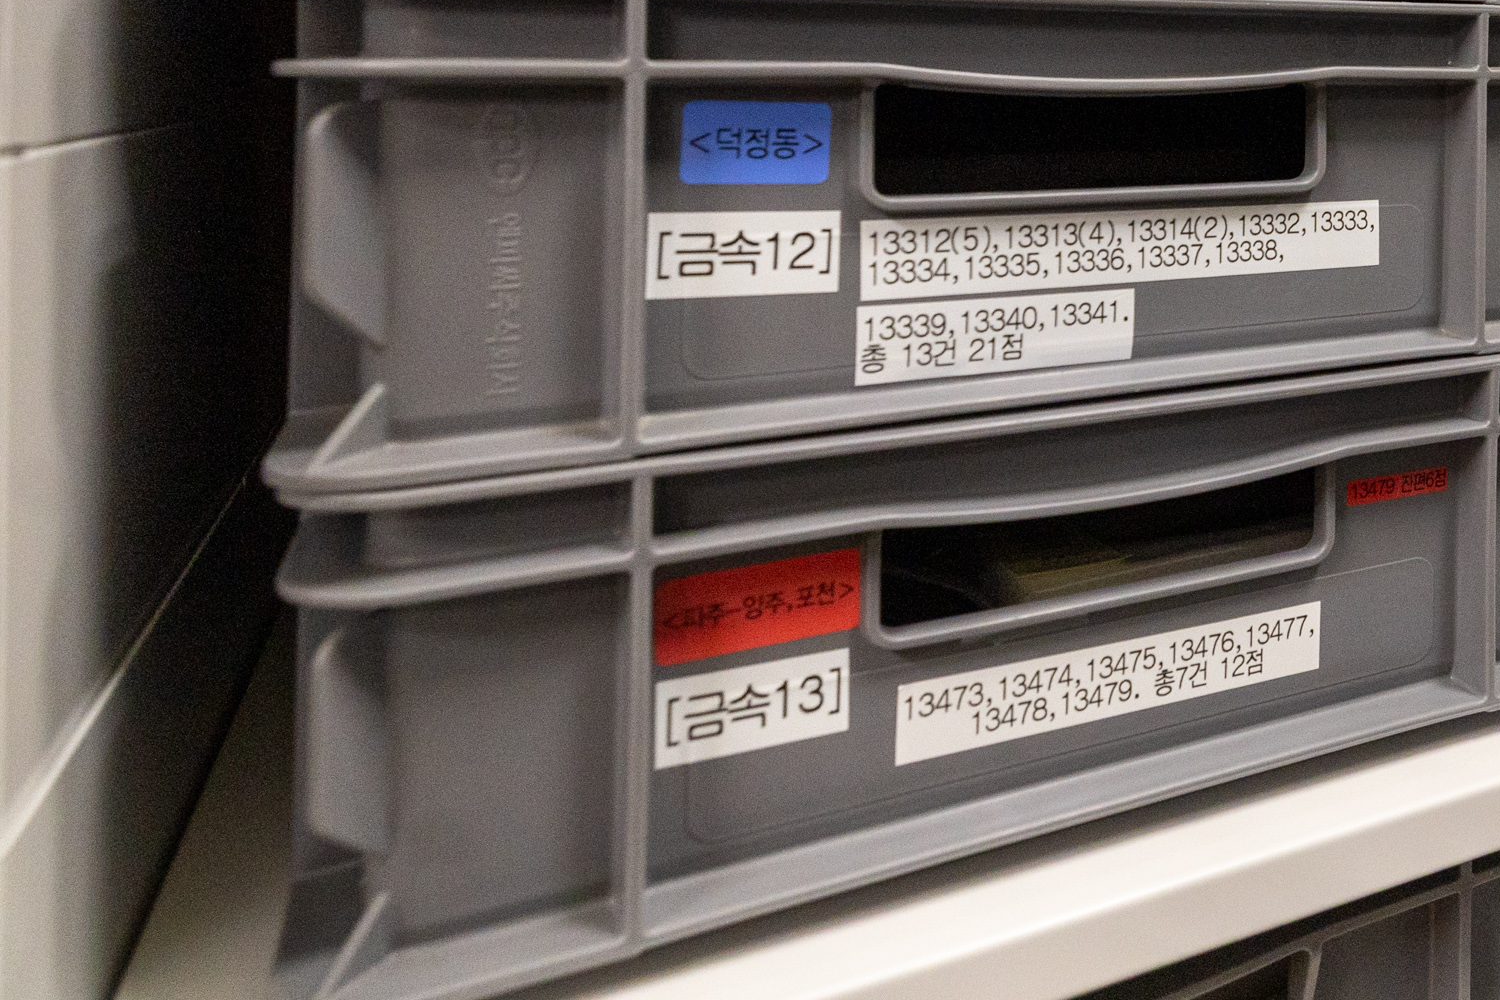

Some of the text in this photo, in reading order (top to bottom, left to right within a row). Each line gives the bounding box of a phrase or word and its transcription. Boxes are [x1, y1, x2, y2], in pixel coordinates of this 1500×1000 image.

[690, 129, 823, 160] <덕정동>
[657, 230, 833, 280] [금속12]
[861, 335, 1023, 374] 총 13건 21점
[1352, 478, 1395, 499] 13479
[1154, 663, 1208, 703] 총7건
[1223, 648, 1264, 681] 12점
[666, 668, 841, 748] [금속13]
